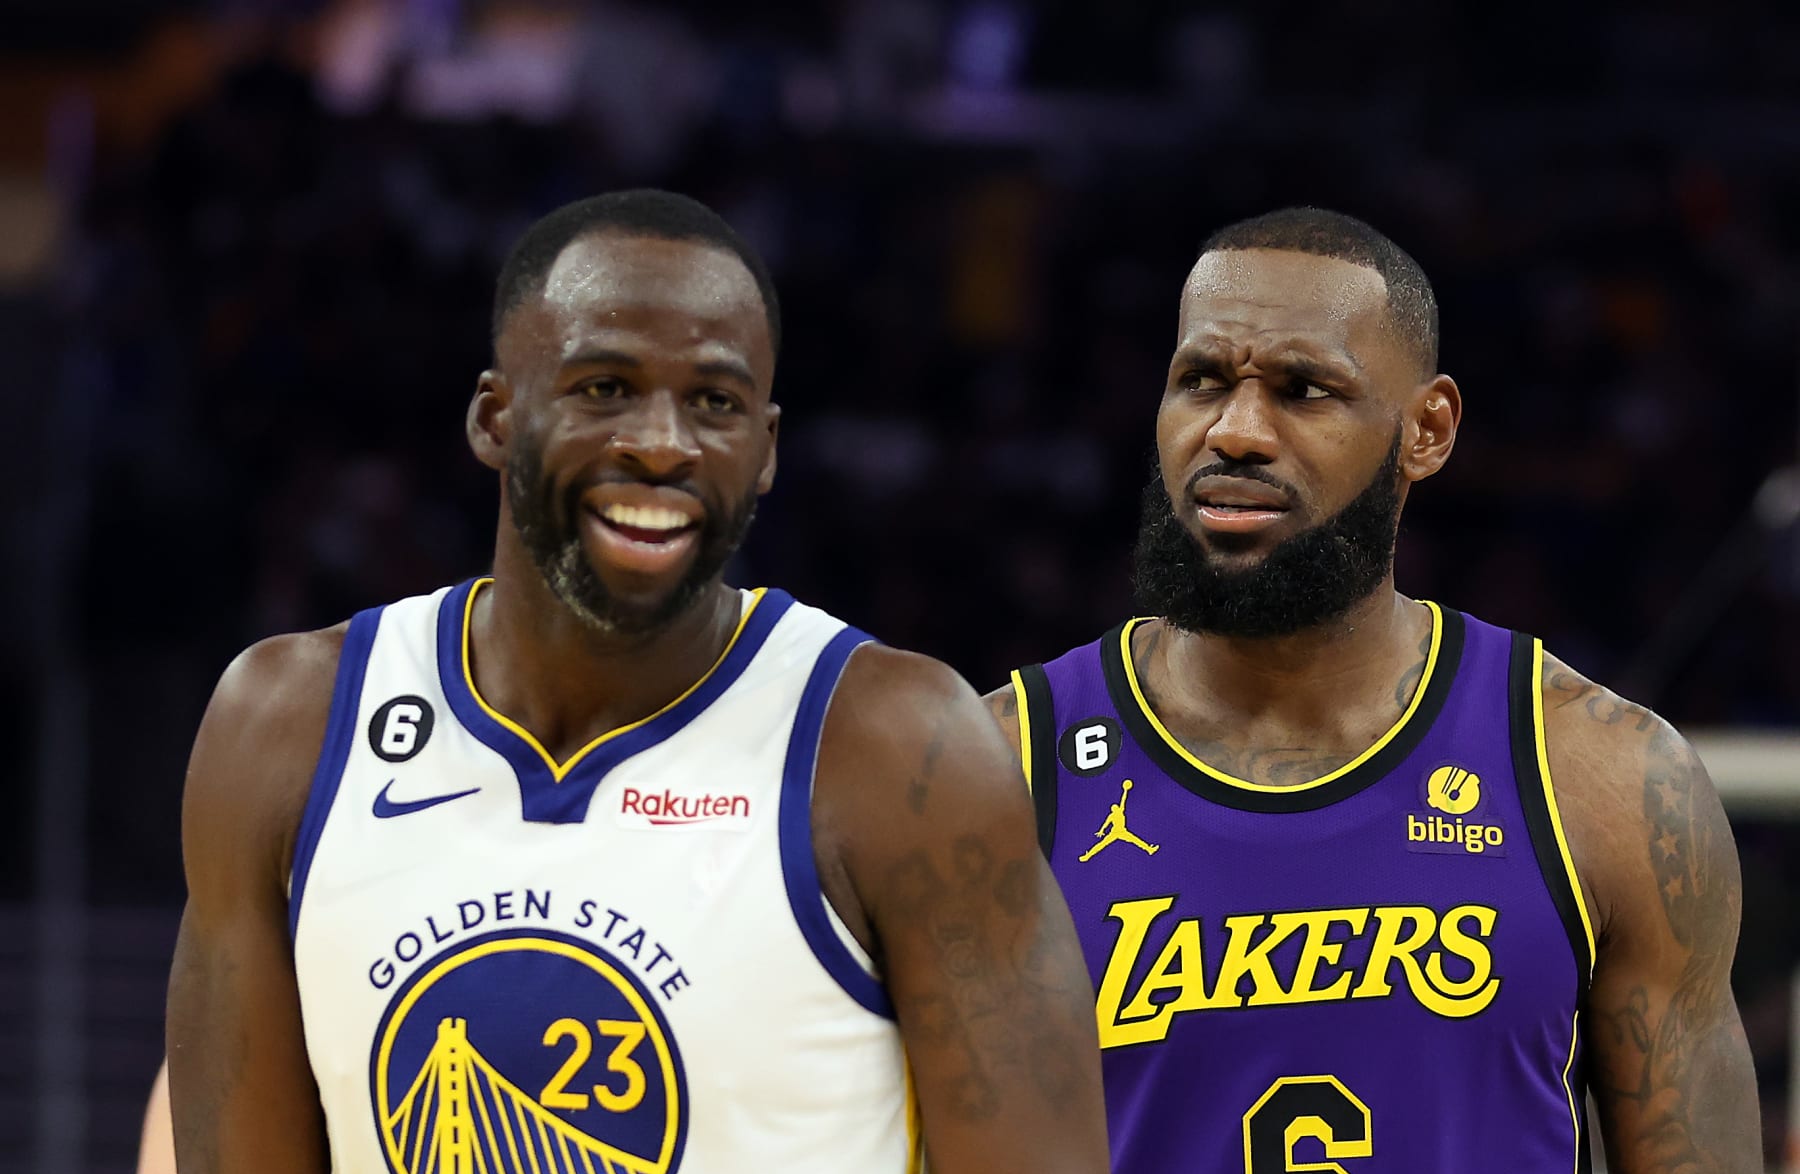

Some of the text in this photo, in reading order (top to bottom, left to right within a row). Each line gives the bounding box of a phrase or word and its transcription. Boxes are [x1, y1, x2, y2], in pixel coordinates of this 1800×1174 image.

[380, 703, 422, 755] 6
[1074, 724, 1109, 770] 6
[621, 787, 750, 818] Rakuten
[1407, 814, 1504, 853] bibigo
[369, 889, 690, 1000] GOLDEN STATE
[1096, 894, 1500, 1049] LAKERS
[540, 1017, 646, 1112] 23
